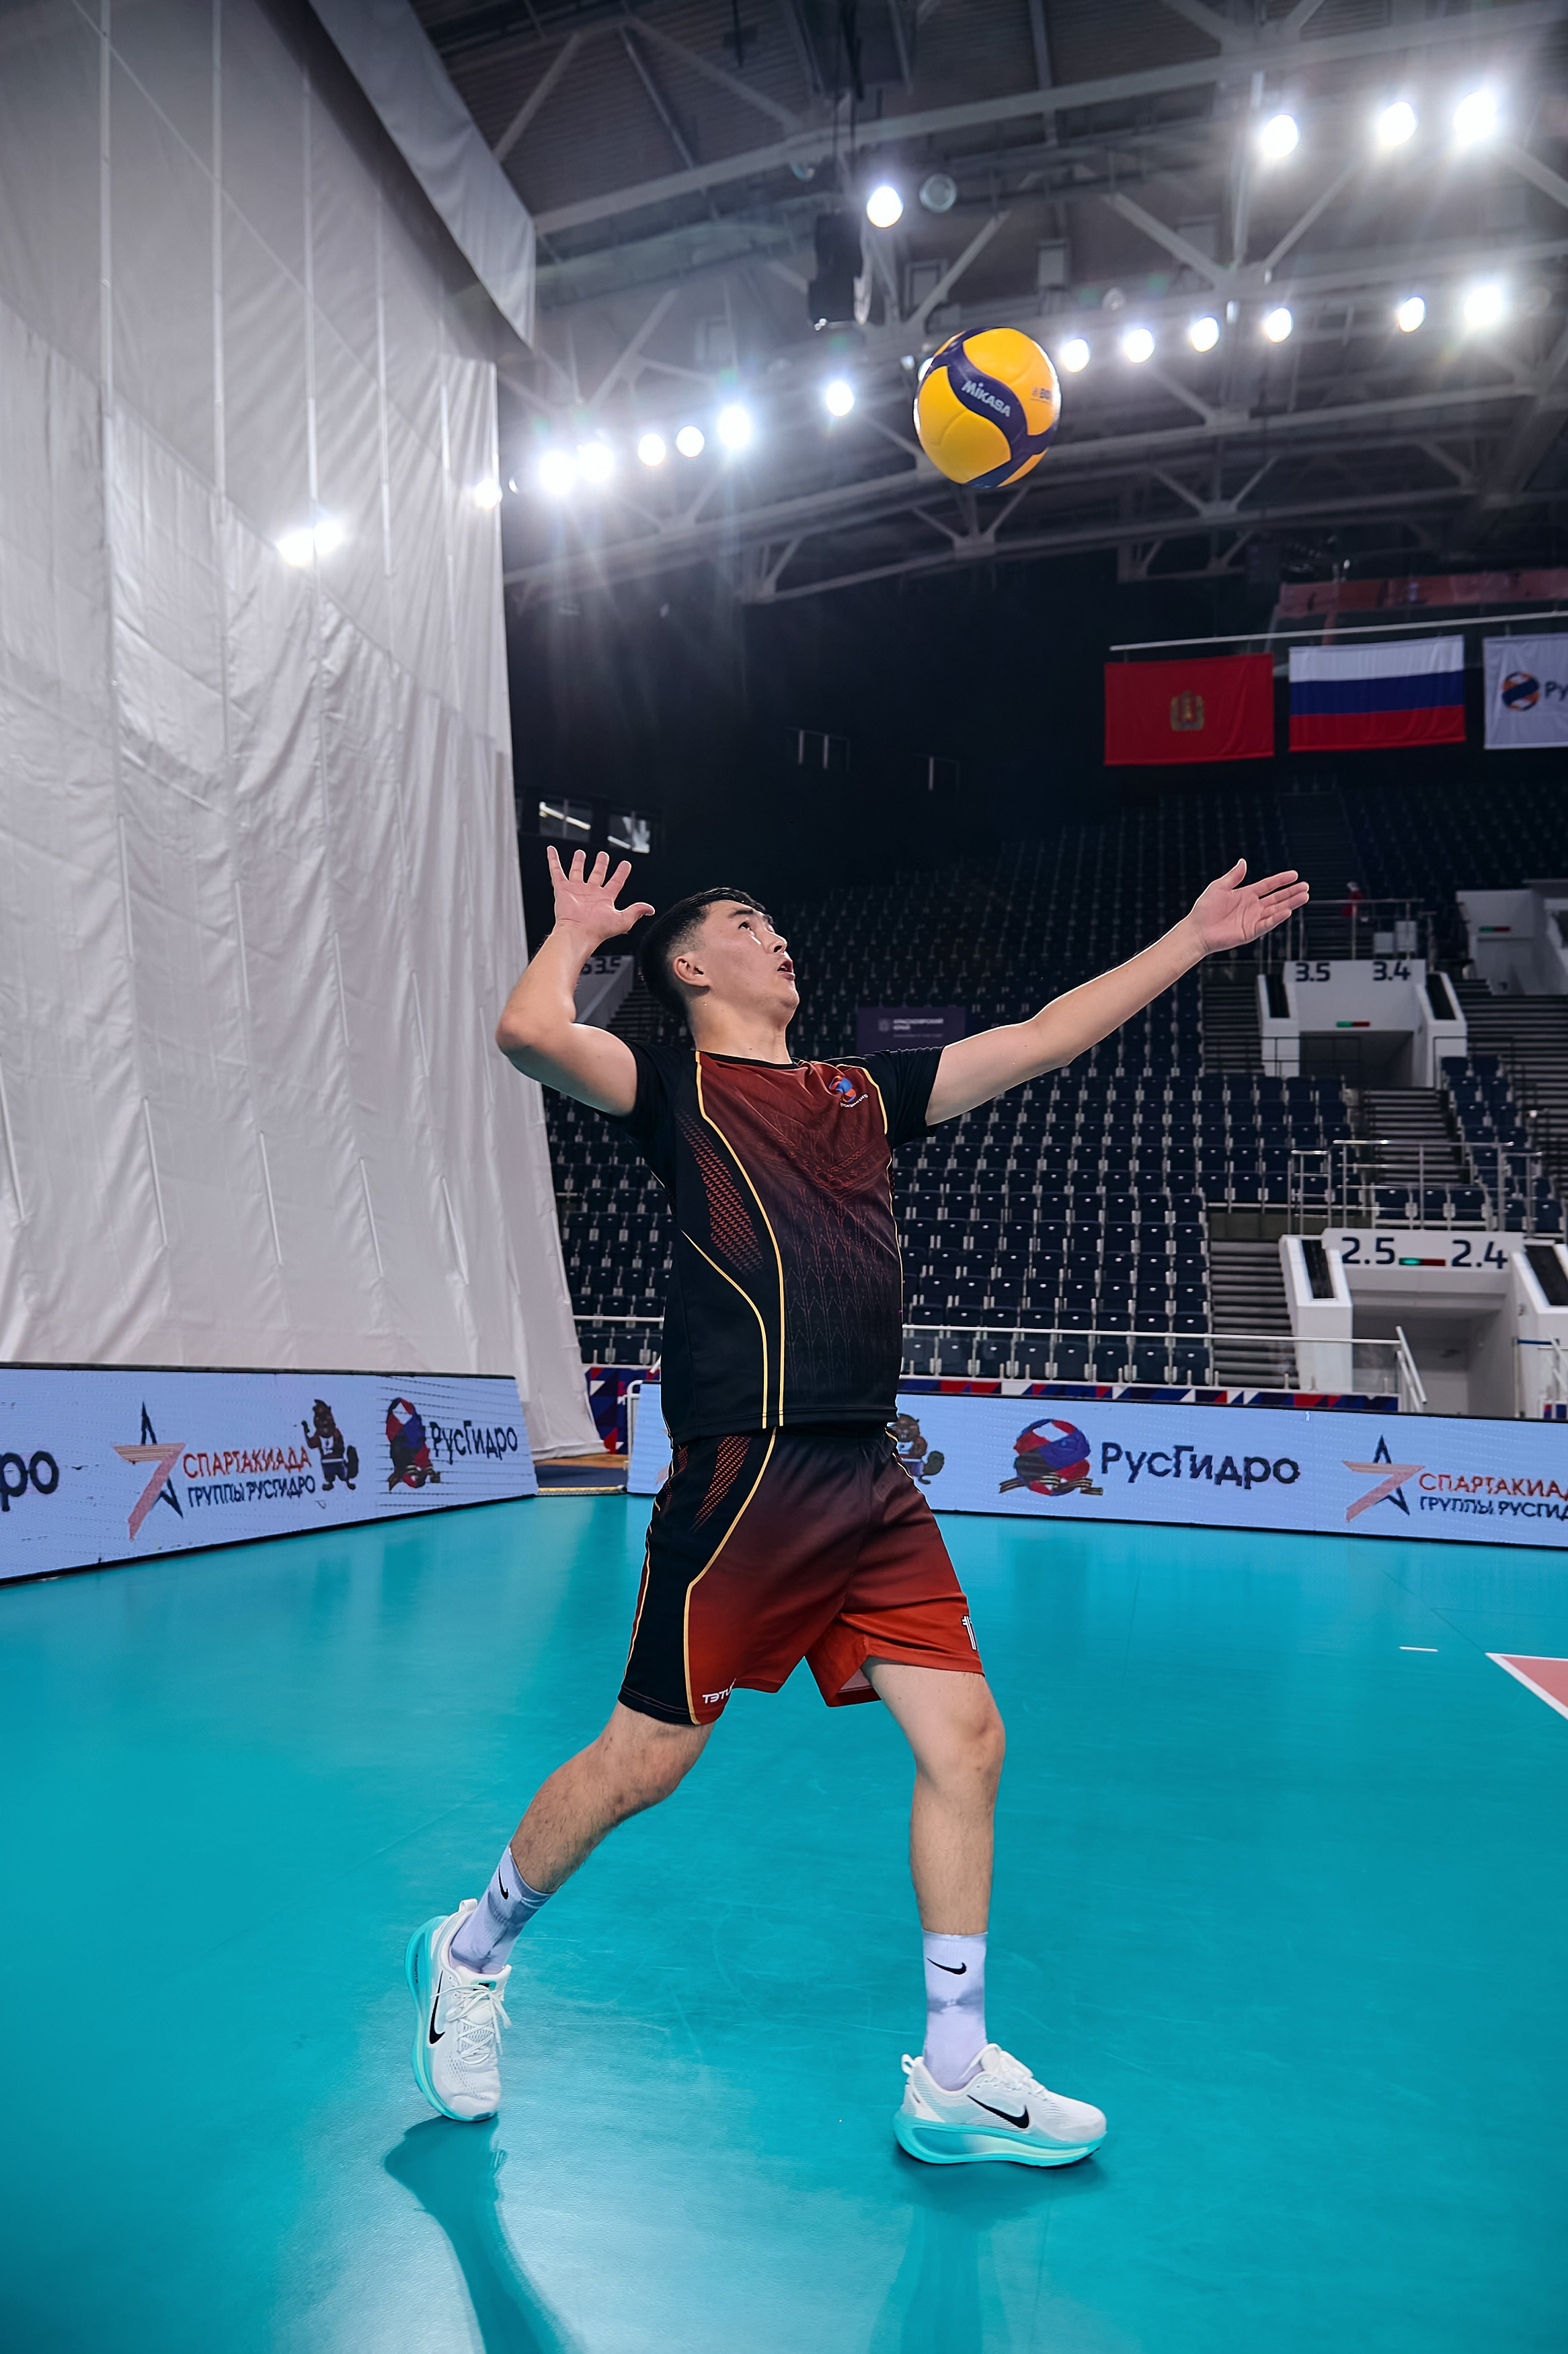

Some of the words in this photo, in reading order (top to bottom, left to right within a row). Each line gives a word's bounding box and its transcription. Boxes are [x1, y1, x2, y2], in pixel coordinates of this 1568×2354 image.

[1295, 962, 1331, 982] 3.5
[1372, 960, 1411, 981] 3.4
[1341, 1237, 1395, 1264] 2.5
[1451, 1240, 1508, 1269] 2.4
[429, 1420, 518, 1465] РусГидро
[183, 1445, 312, 1479] СПАРТАКИАДА
[1101, 1441, 1300, 1490] РусГидро
[188, 1483, 245, 1508] ГРУППЫ
[246, 1475, 315, 1503] РУСГИДРО
[1420, 1496, 1494, 1515] ГРУППЫ
